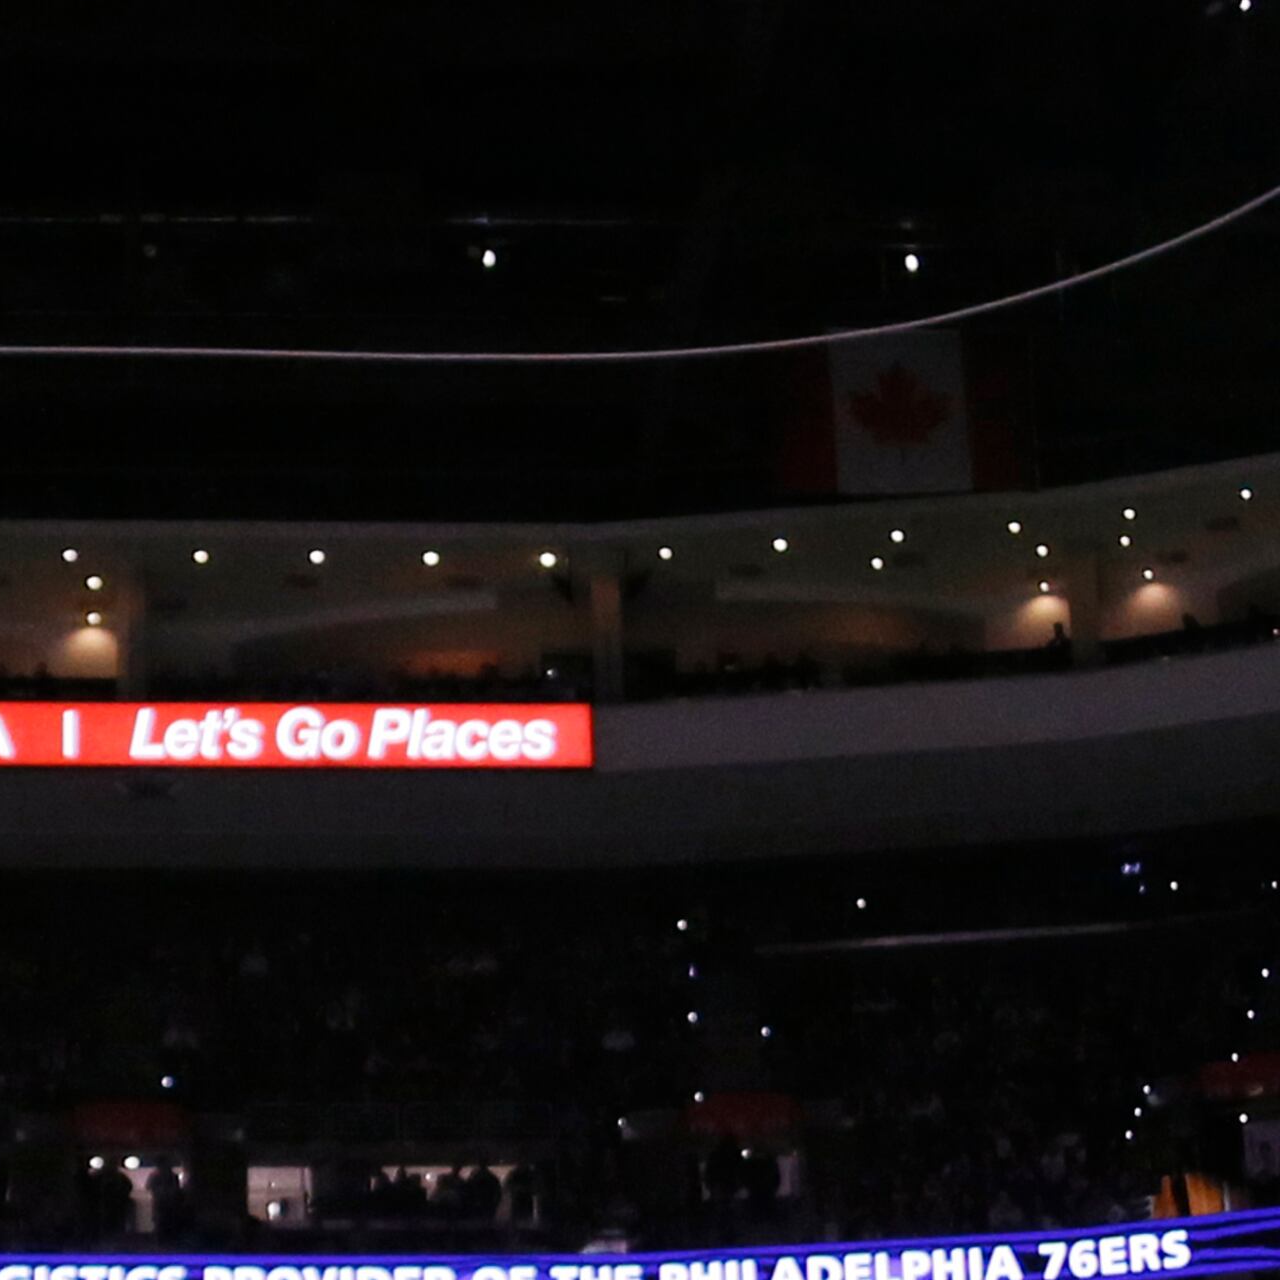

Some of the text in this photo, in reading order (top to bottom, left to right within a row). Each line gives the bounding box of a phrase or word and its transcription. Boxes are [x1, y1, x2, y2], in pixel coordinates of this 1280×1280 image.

[128, 706, 264, 760] Let's
[275, 713, 360, 760] Go
[366, 706, 557, 760] Places
